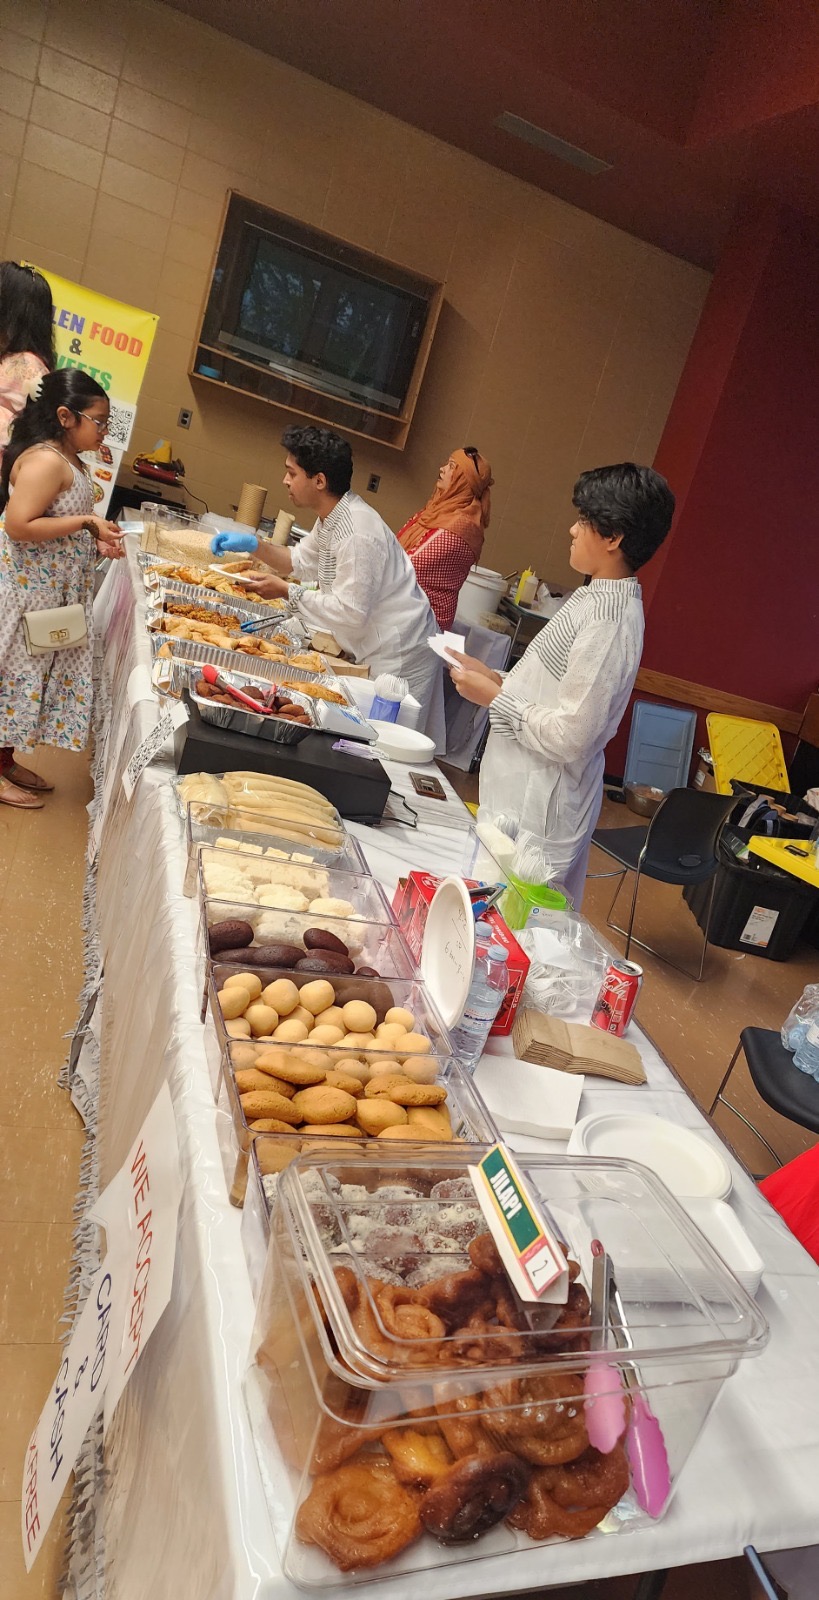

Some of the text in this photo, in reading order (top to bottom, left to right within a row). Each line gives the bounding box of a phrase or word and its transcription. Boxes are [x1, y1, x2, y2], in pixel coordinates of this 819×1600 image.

[51, 304, 143, 358] LEN FOOD
[69, 338, 82, 356] &
[489, 1167, 523, 1221] JILAPI
[123, 1138, 153, 1377] WE ACCEPT
[532, 1259, 549, 1278] 2
[90, 1272, 112, 1393] CARD
[50, 1356, 69, 1482] CASH
